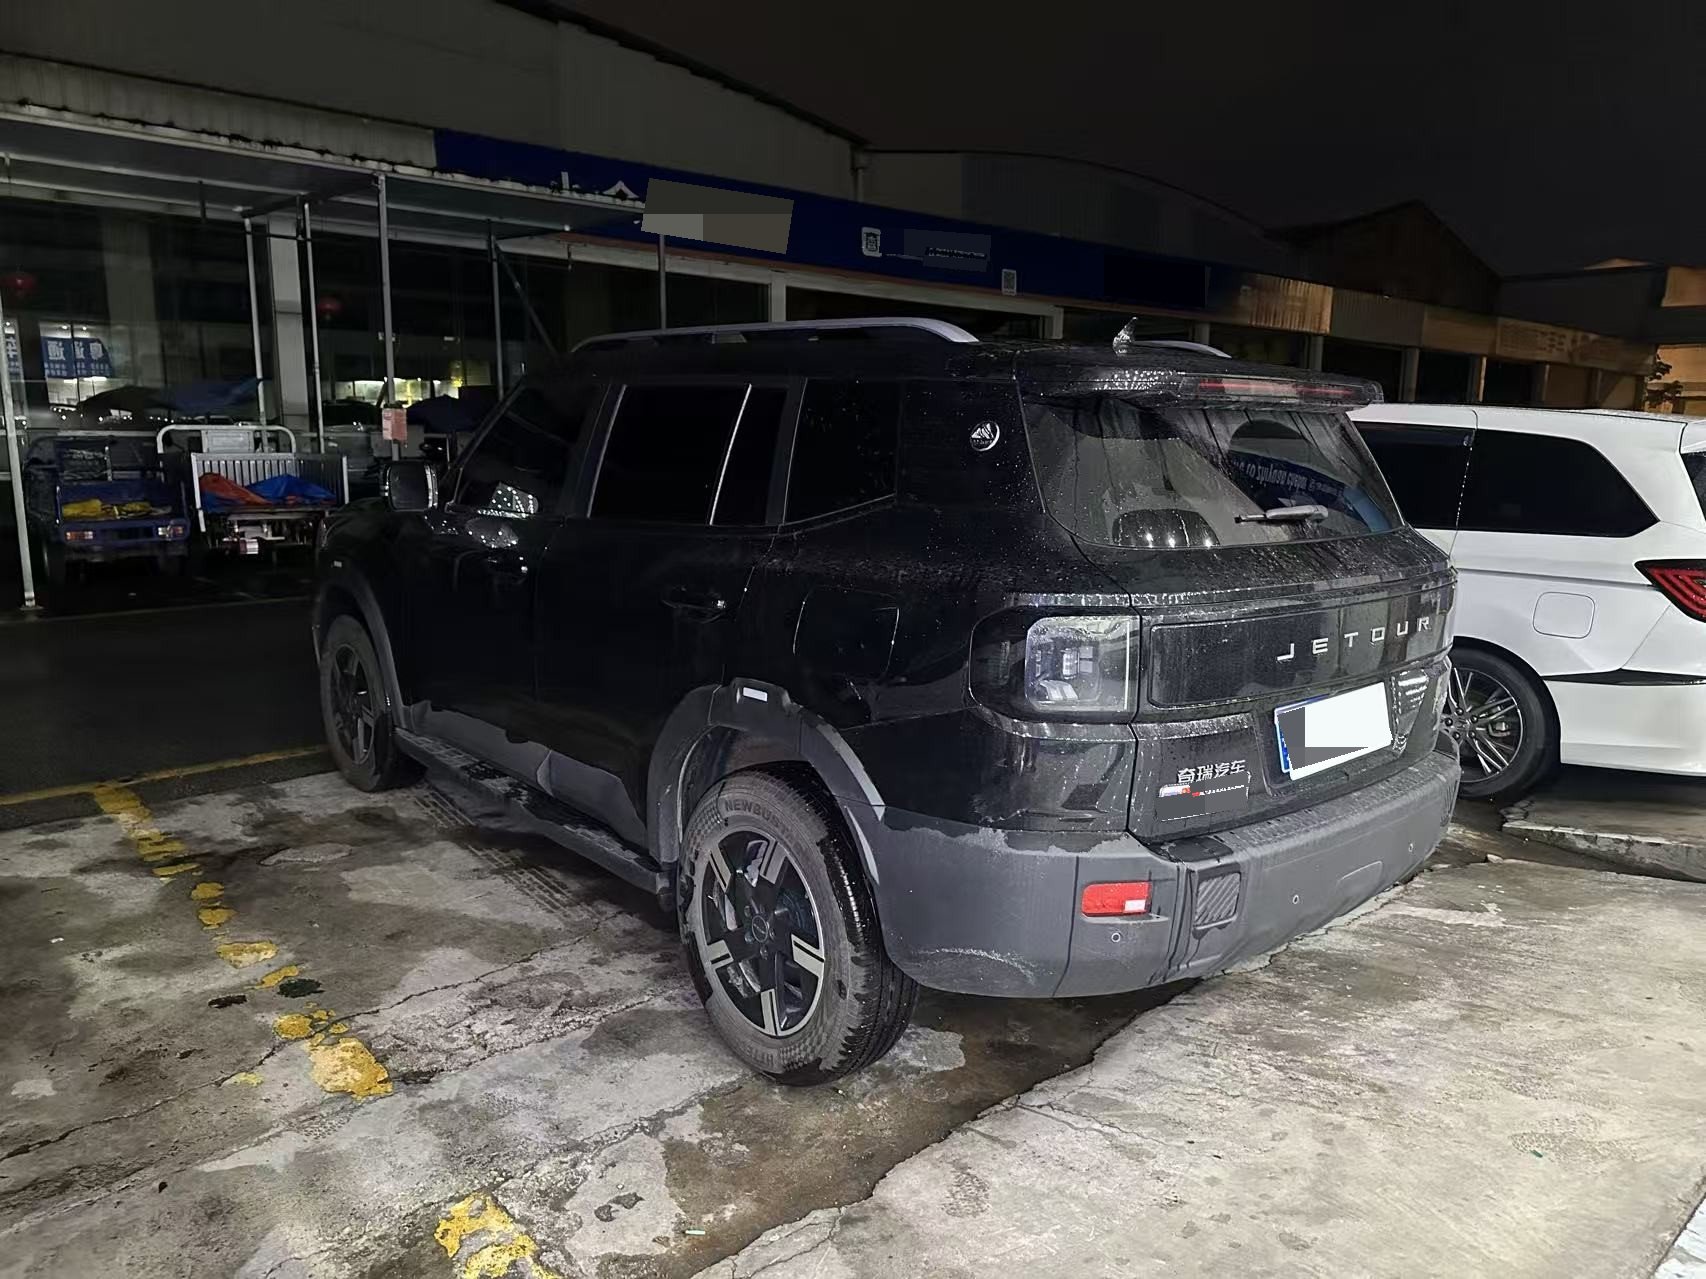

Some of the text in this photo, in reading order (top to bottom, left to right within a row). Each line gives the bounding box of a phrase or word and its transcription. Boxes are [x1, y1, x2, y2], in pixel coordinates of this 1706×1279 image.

[1276, 616, 1431, 662] JETOUR
[1177, 759, 1246, 784] 奇瑞汽车
